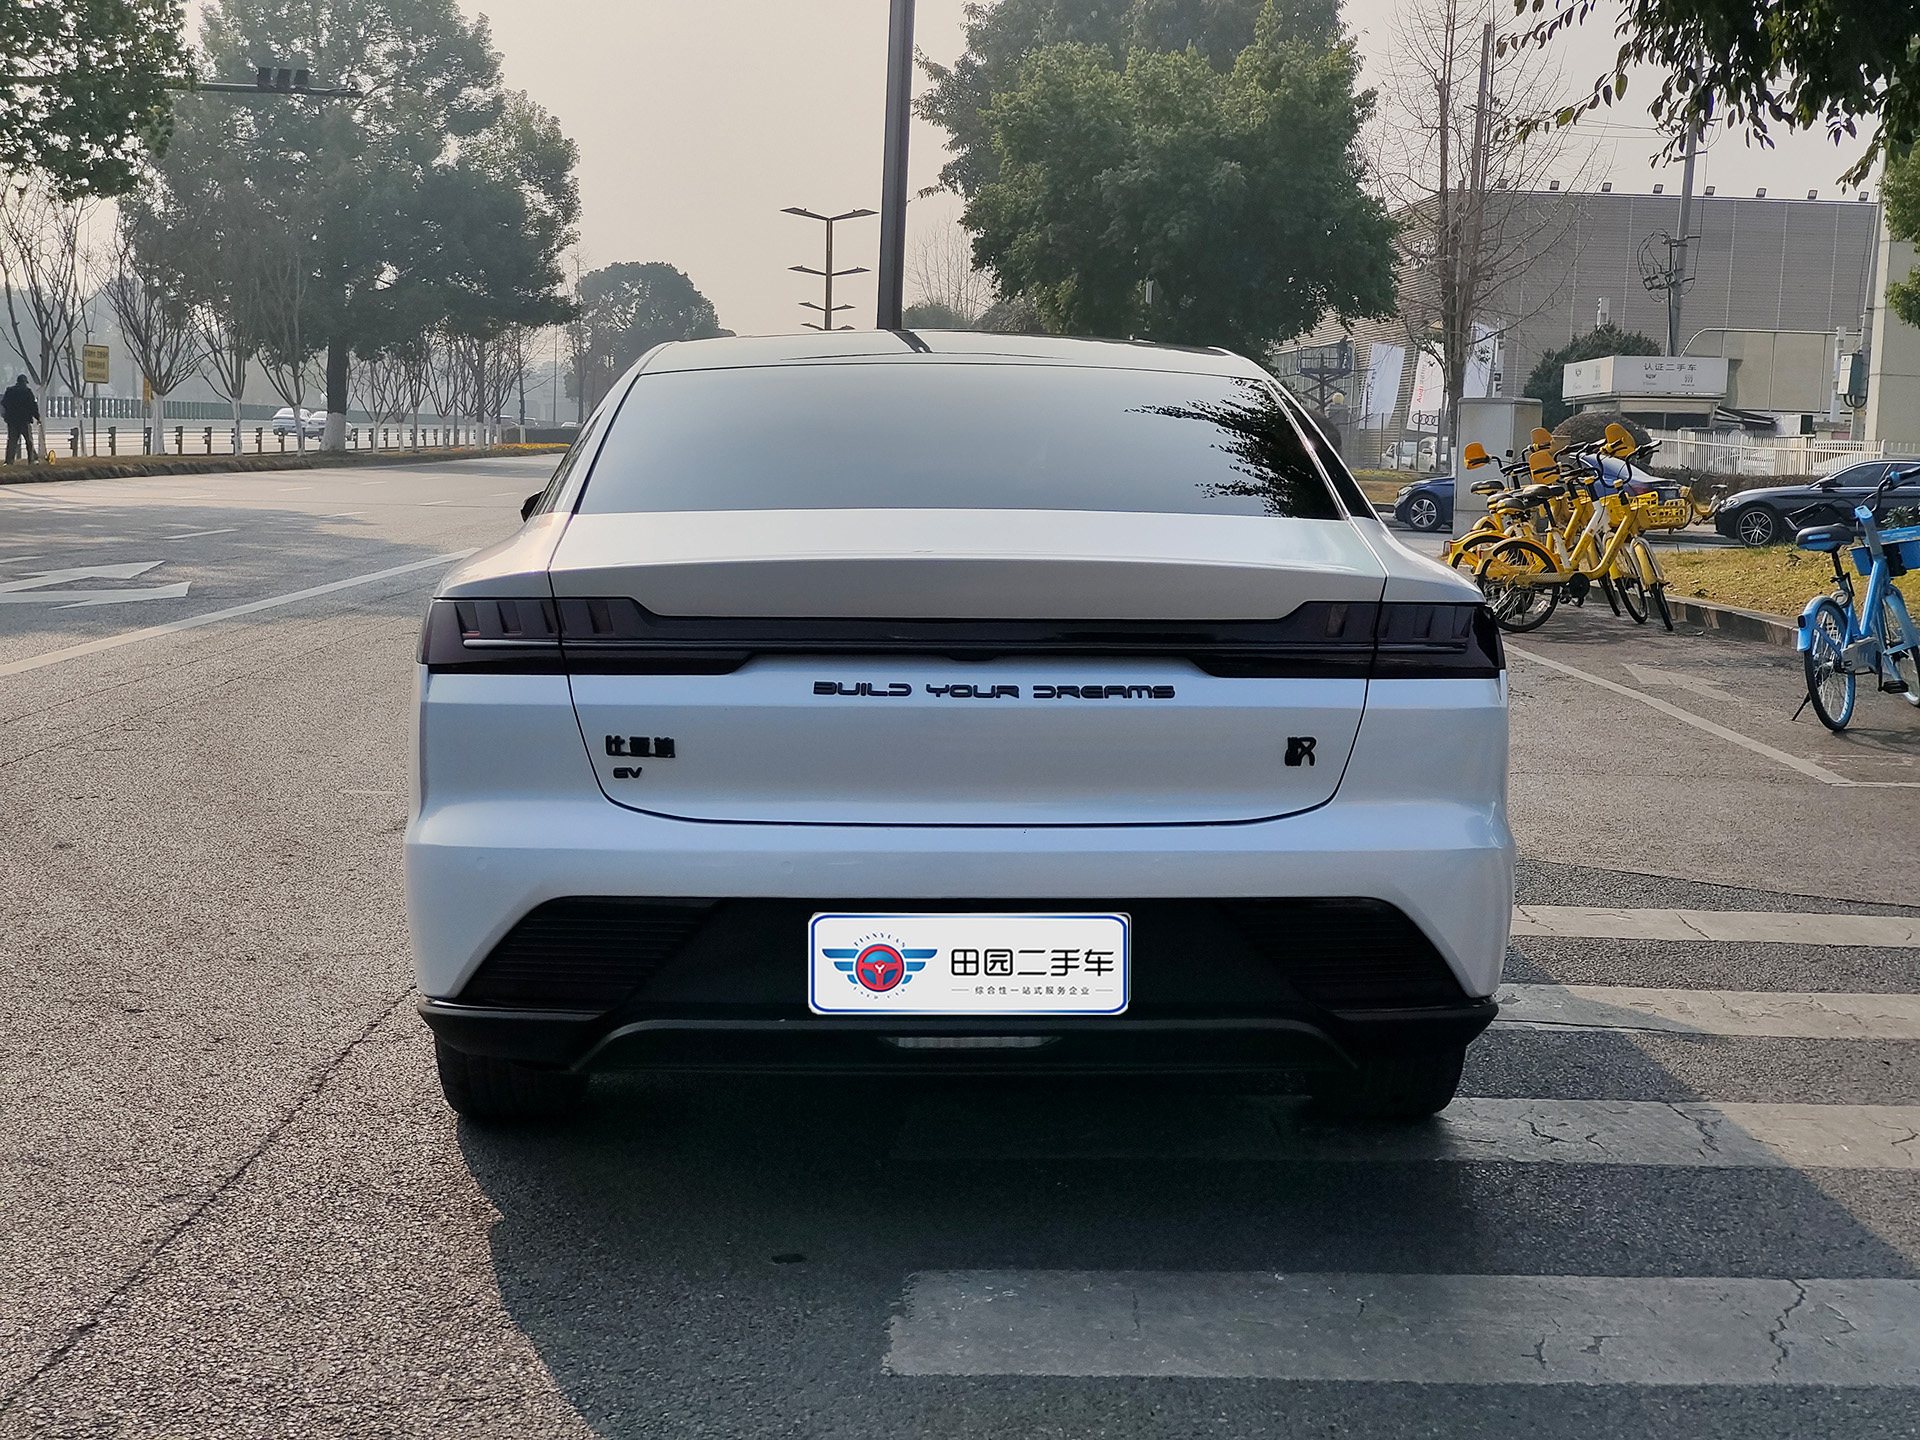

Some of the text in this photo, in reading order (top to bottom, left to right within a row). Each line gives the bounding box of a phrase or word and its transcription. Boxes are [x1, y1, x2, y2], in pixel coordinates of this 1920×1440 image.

[1644, 363, 1698, 372] 认证二手车
[1416, 385, 1424, 403] Audi
[813, 681, 1176, 699] BUILD YOUR DREAMS
[612, 767, 643, 779] EV
